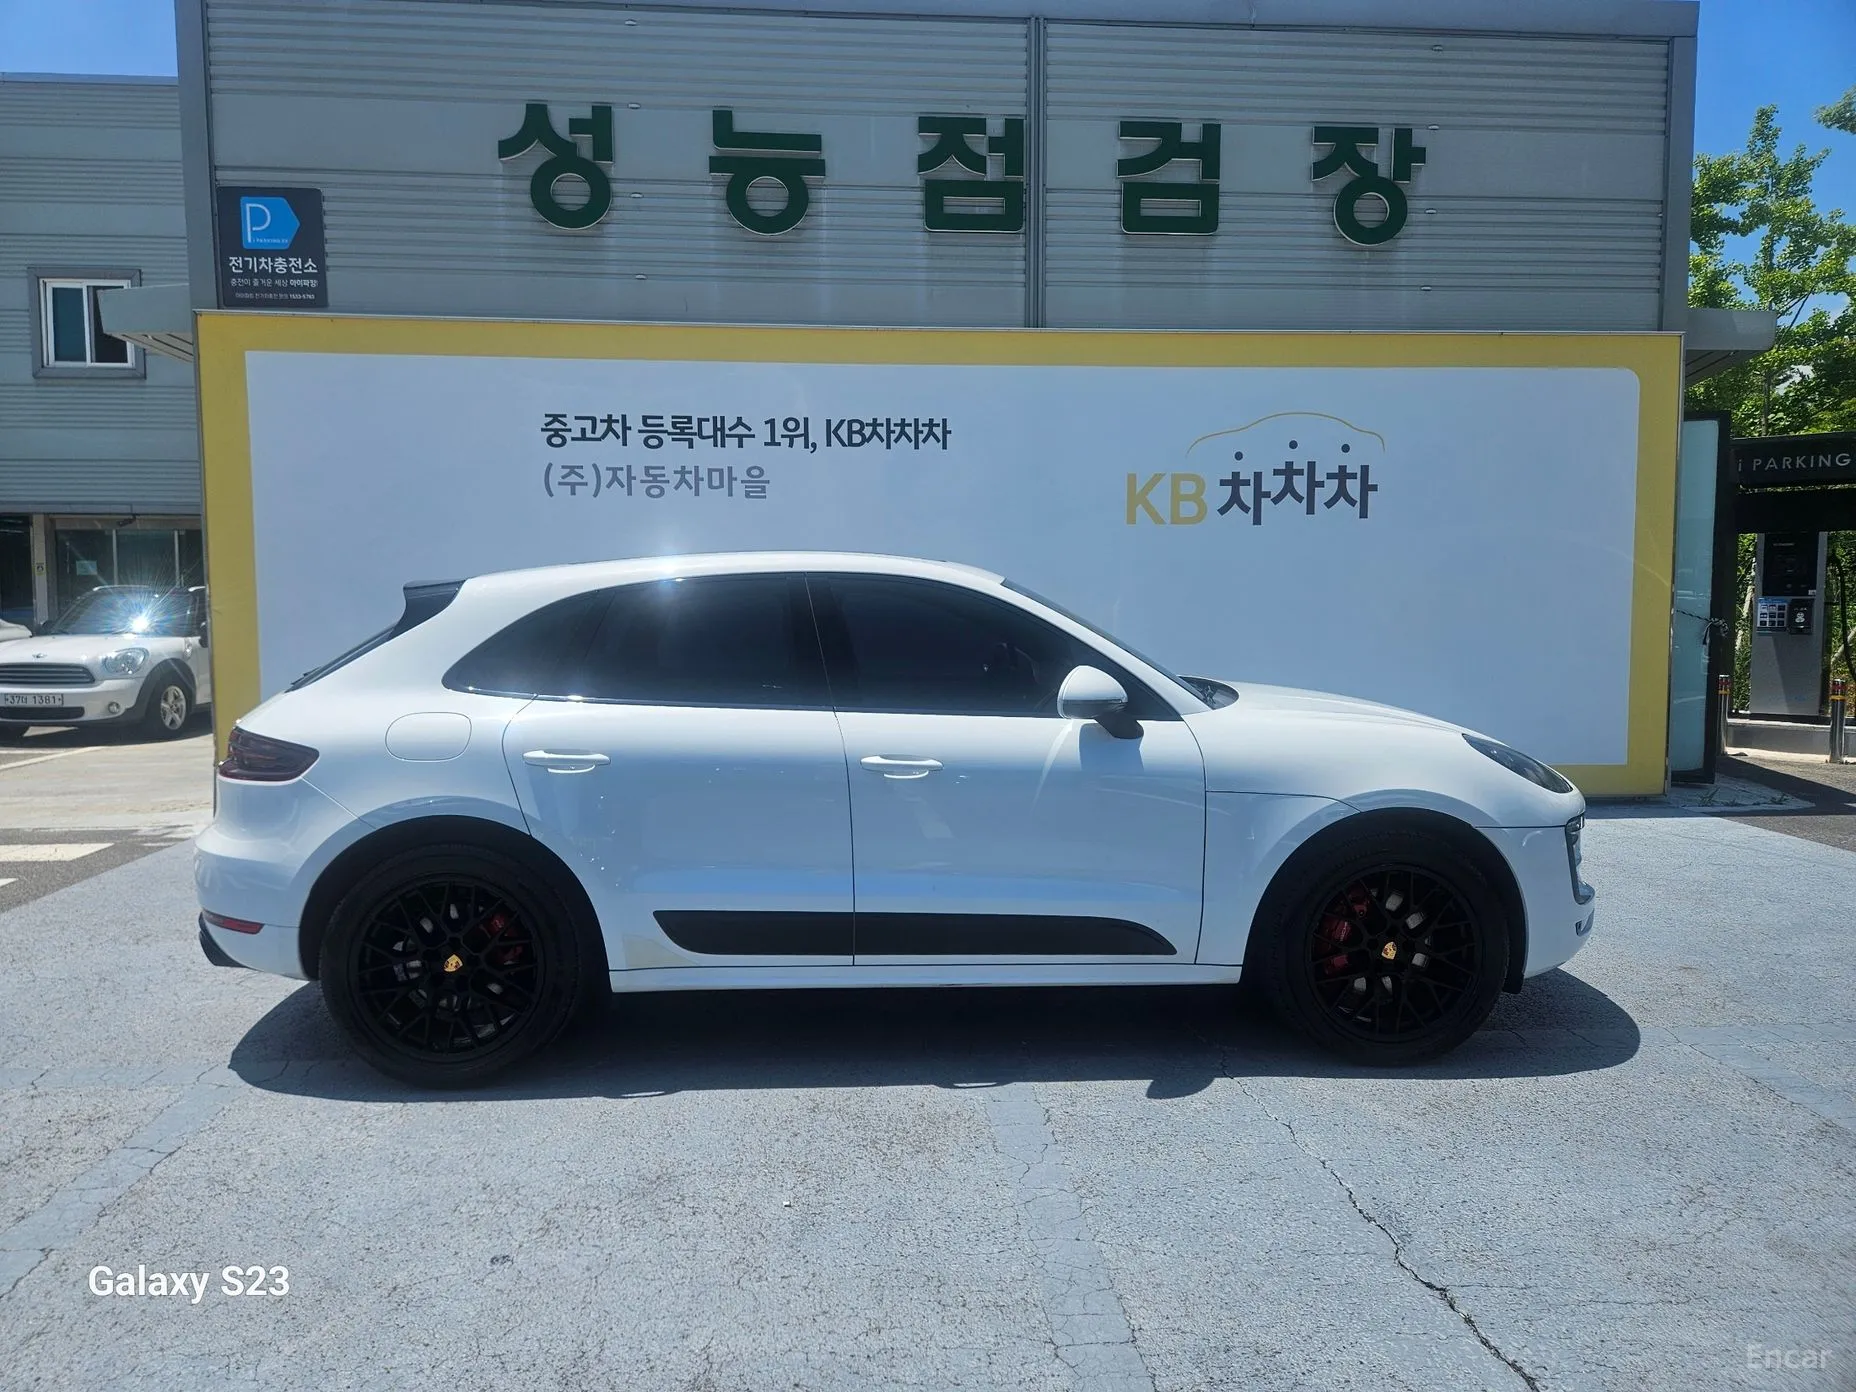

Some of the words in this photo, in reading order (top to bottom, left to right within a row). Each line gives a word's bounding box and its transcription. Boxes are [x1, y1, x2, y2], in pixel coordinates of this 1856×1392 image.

[497, 103, 1427, 246] 성능점검장
[229, 256, 318, 274] 전기차충전소
[230, 278, 251, 287] 충전이
[275, 279, 288, 287] 세상
[540, 413, 632, 449] 중고차
[638, 413, 756, 450] 등록대수
[763, 416, 818, 453] 1위,
[825, 416, 952, 451] KB차차차
[1737, 458, 1743, 472] i
[1752, 452, 1852, 472] PARKING
[543, 461, 770, 499] (주)자동차마을
[1126, 472, 1208, 525] KB
[1217, 439, 1379, 526] 차차차
[33, 695, 56, 705] 1381
